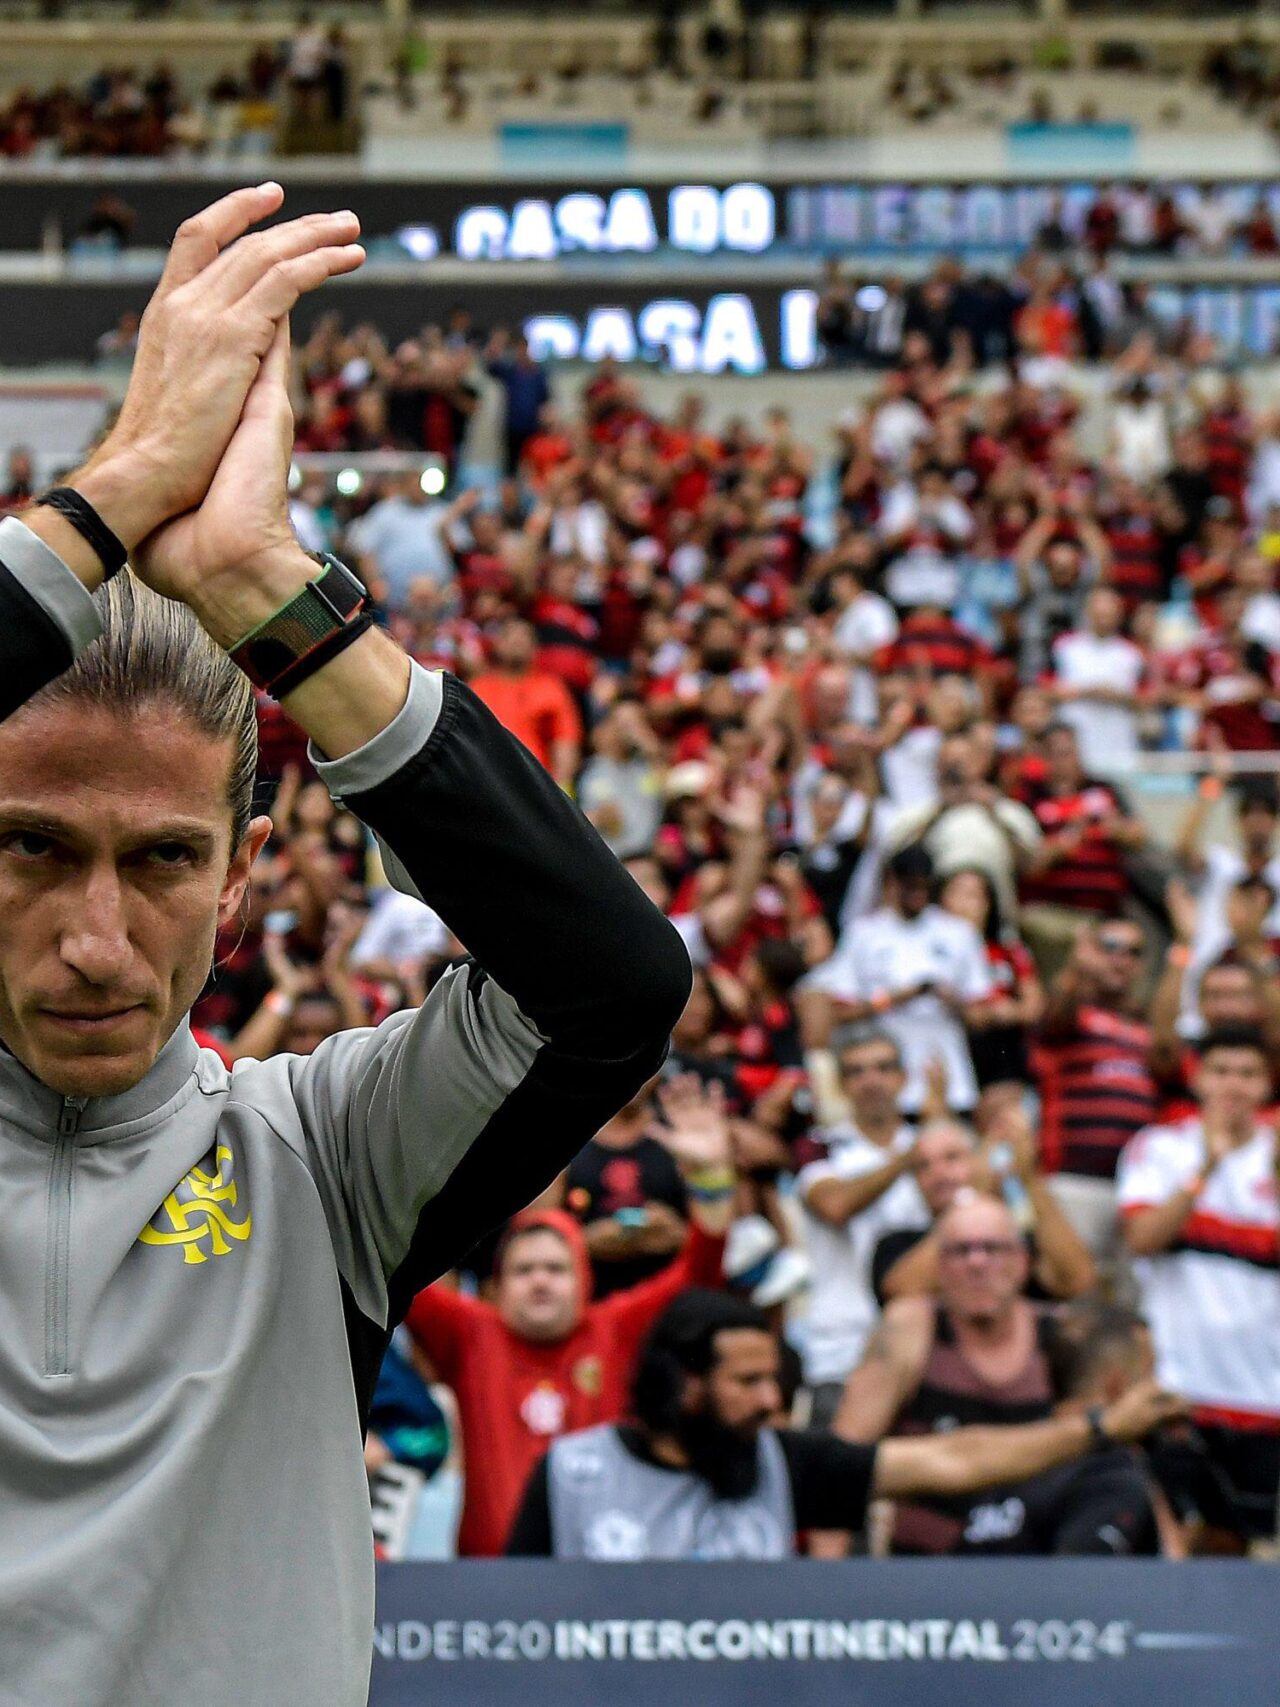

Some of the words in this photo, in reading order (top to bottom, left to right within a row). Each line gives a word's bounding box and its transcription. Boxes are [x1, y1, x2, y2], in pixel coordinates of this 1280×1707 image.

[668, 181, 775, 254] DO
[554, 1619, 1009, 1662] INTERCONTINENTAL
[1011, 1618, 1128, 1662] 2024
